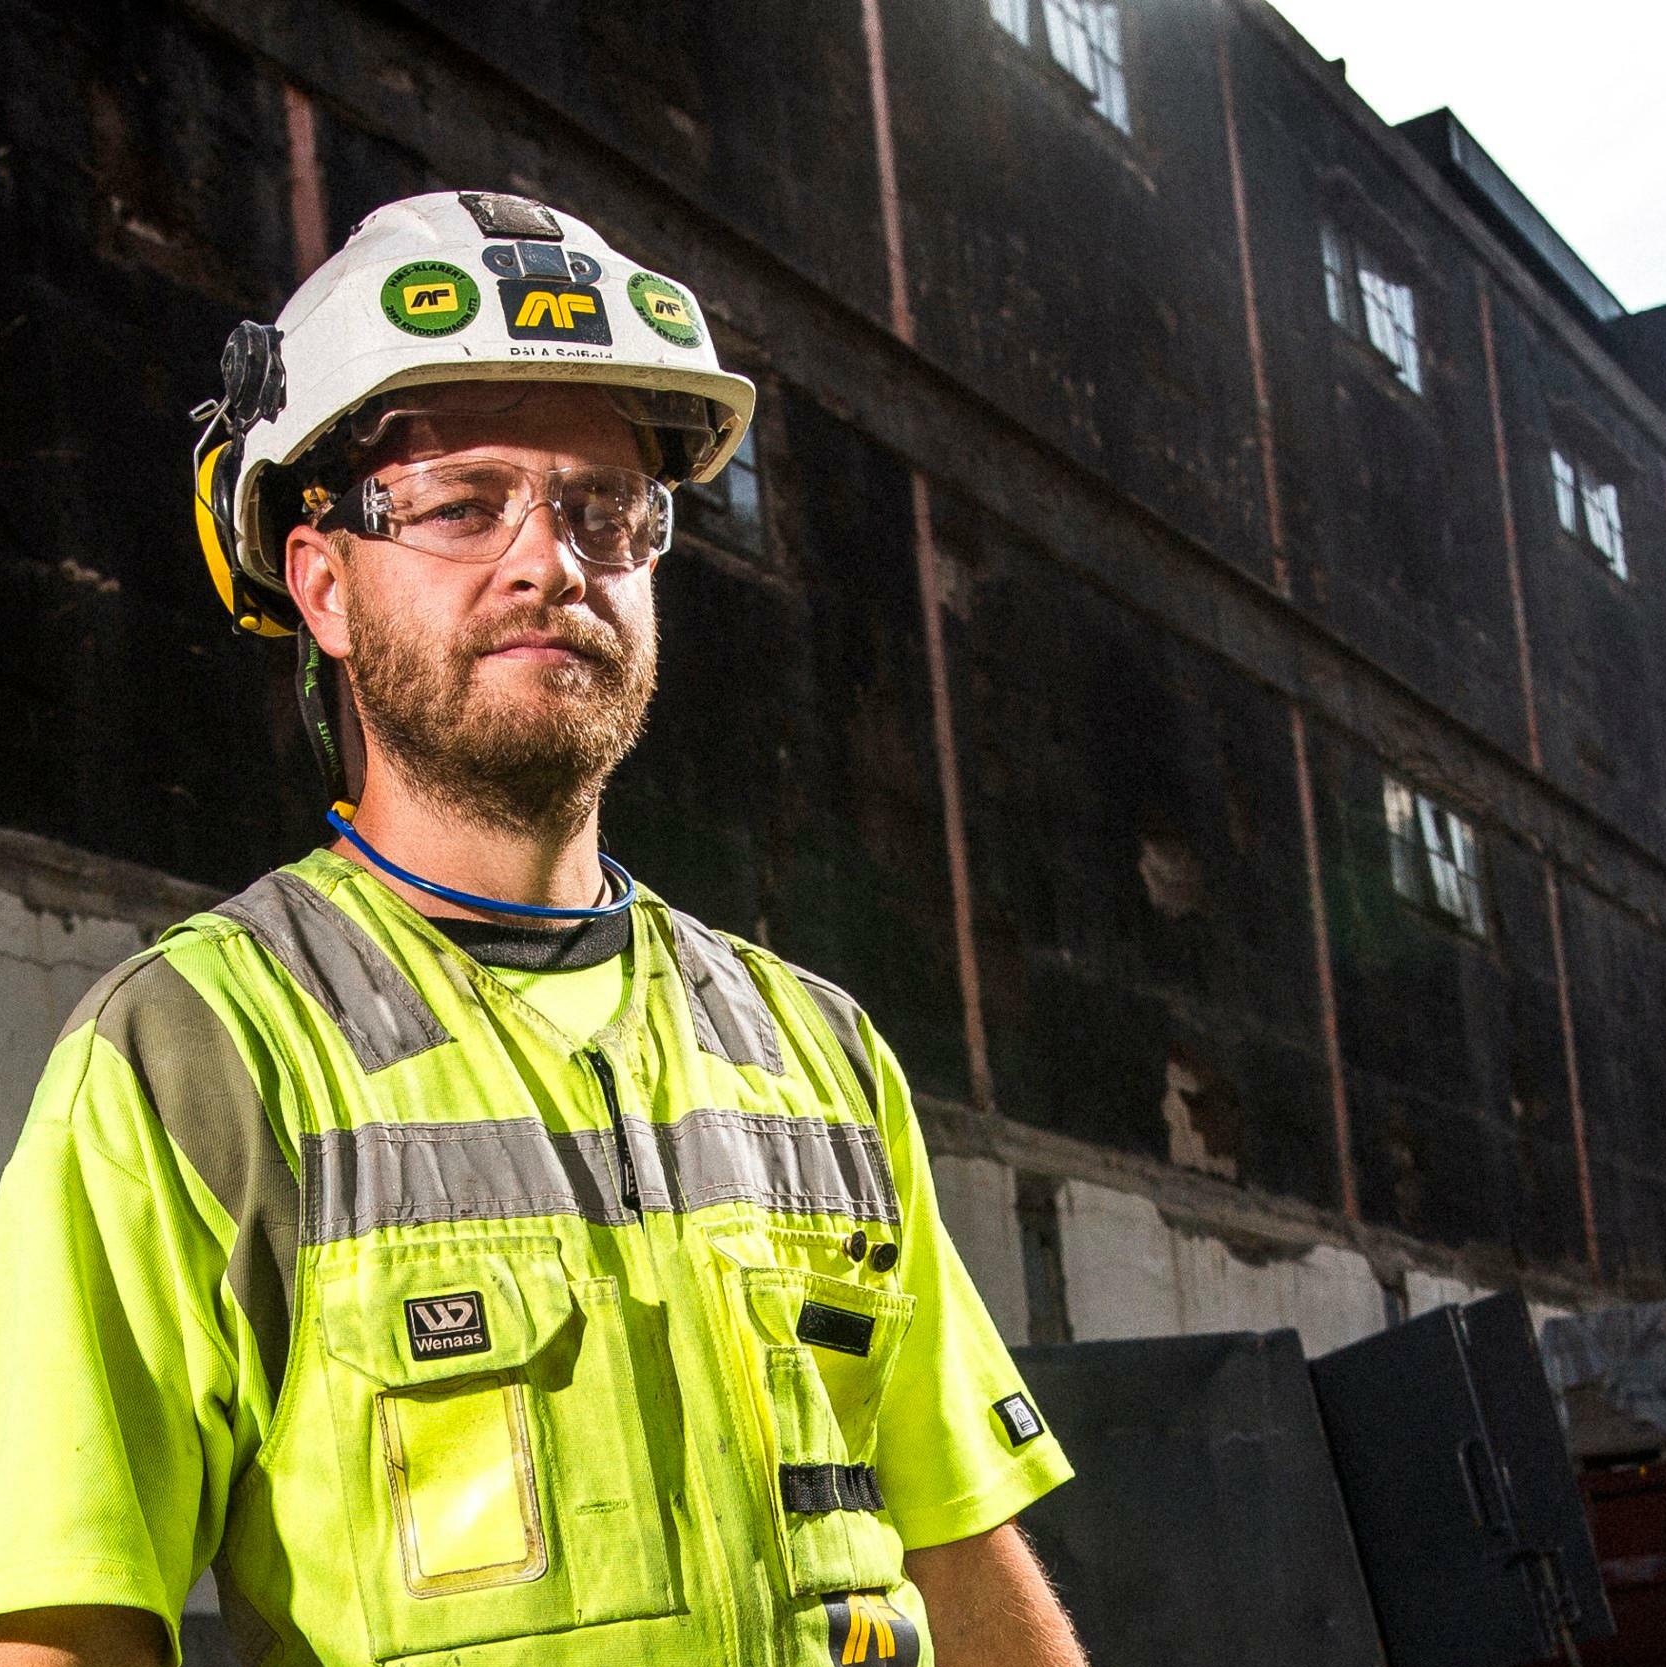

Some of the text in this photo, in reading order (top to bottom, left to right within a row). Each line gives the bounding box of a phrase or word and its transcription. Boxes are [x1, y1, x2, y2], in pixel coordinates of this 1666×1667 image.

[411, 289, 450, 308] AF
[515, 291, 596, 328] AF
[415, 1333, 483, 1352] Wenaas
